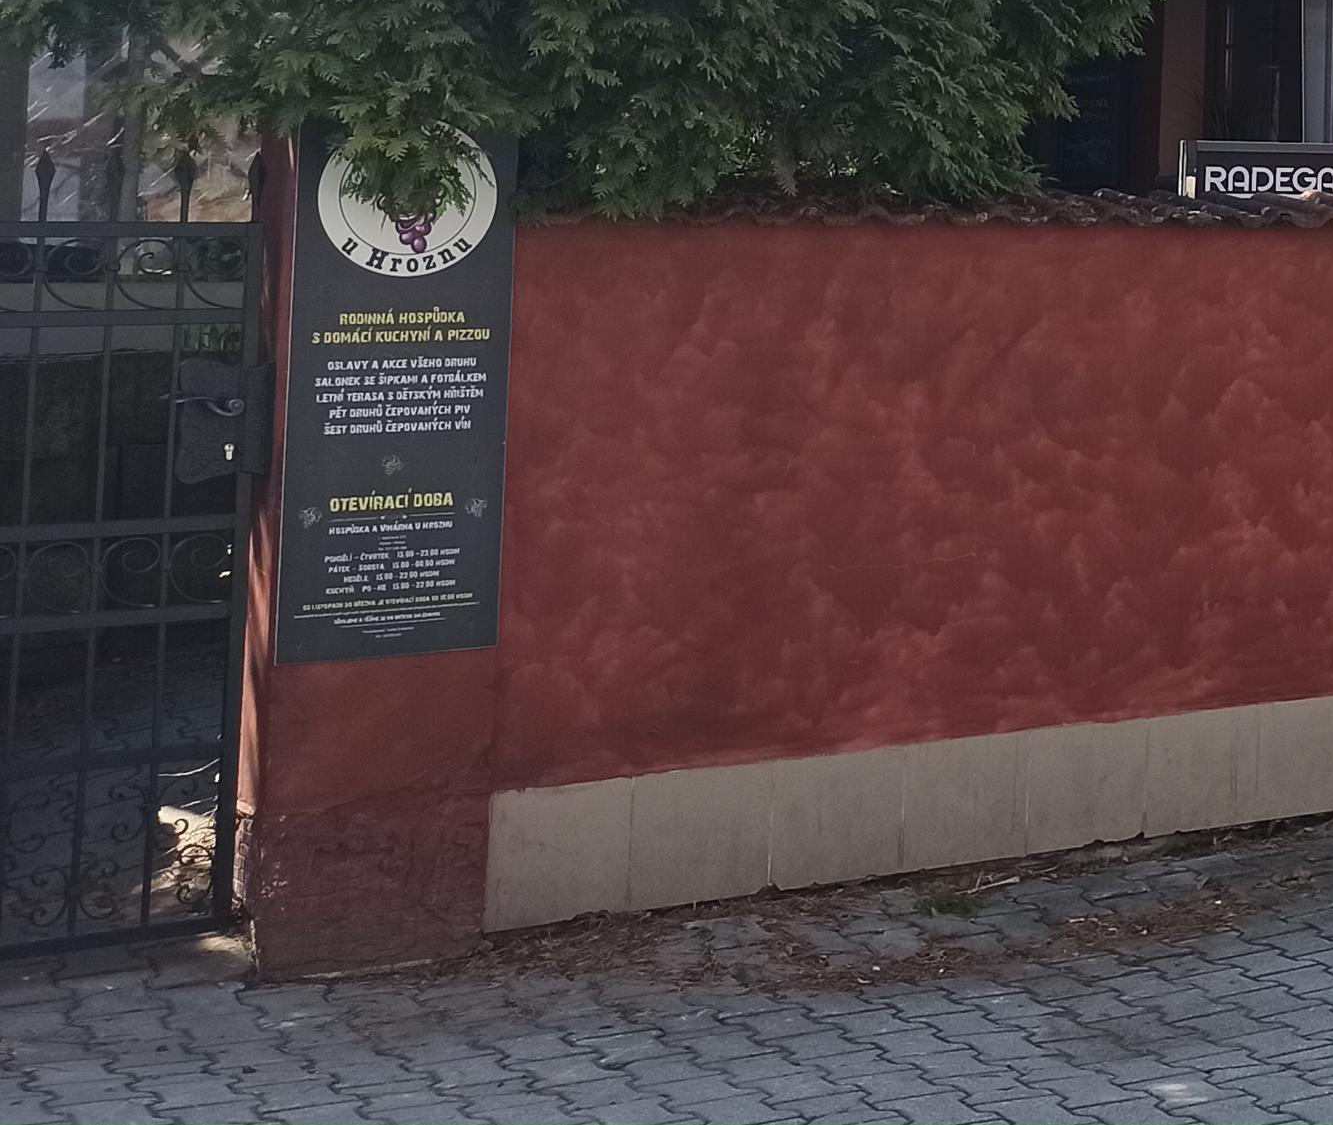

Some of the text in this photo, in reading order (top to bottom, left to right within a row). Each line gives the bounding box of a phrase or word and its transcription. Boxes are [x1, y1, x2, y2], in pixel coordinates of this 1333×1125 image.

[365, 237, 473, 273] Hroznu
[339, 306, 466, 325] RODINNÁ HOSPŮDKA
[311, 327, 490, 344] S DOMÁCÍ KUCHYNÍ A PIZZOU
[327, 356, 477, 371] OSLAVY A AKCE VŠEHO DRUHU
[314, 369, 487, 387] SALONEK SE ŠIPKAMI A FOTBÁLKEM
[316, 384, 484, 403] LETNÍ TERASA S DĚTSKÝM HŘIŠTĚM
[329, 400, 471, 419] PĚT DRUHŮ ČEPOVANÝCH PIV
[323, 416, 472, 435] ŠEST DRUHŮ ČEPOVANÝCH VÍN
[329, 487, 454, 512] OTEVÍRACÍ DOBA
